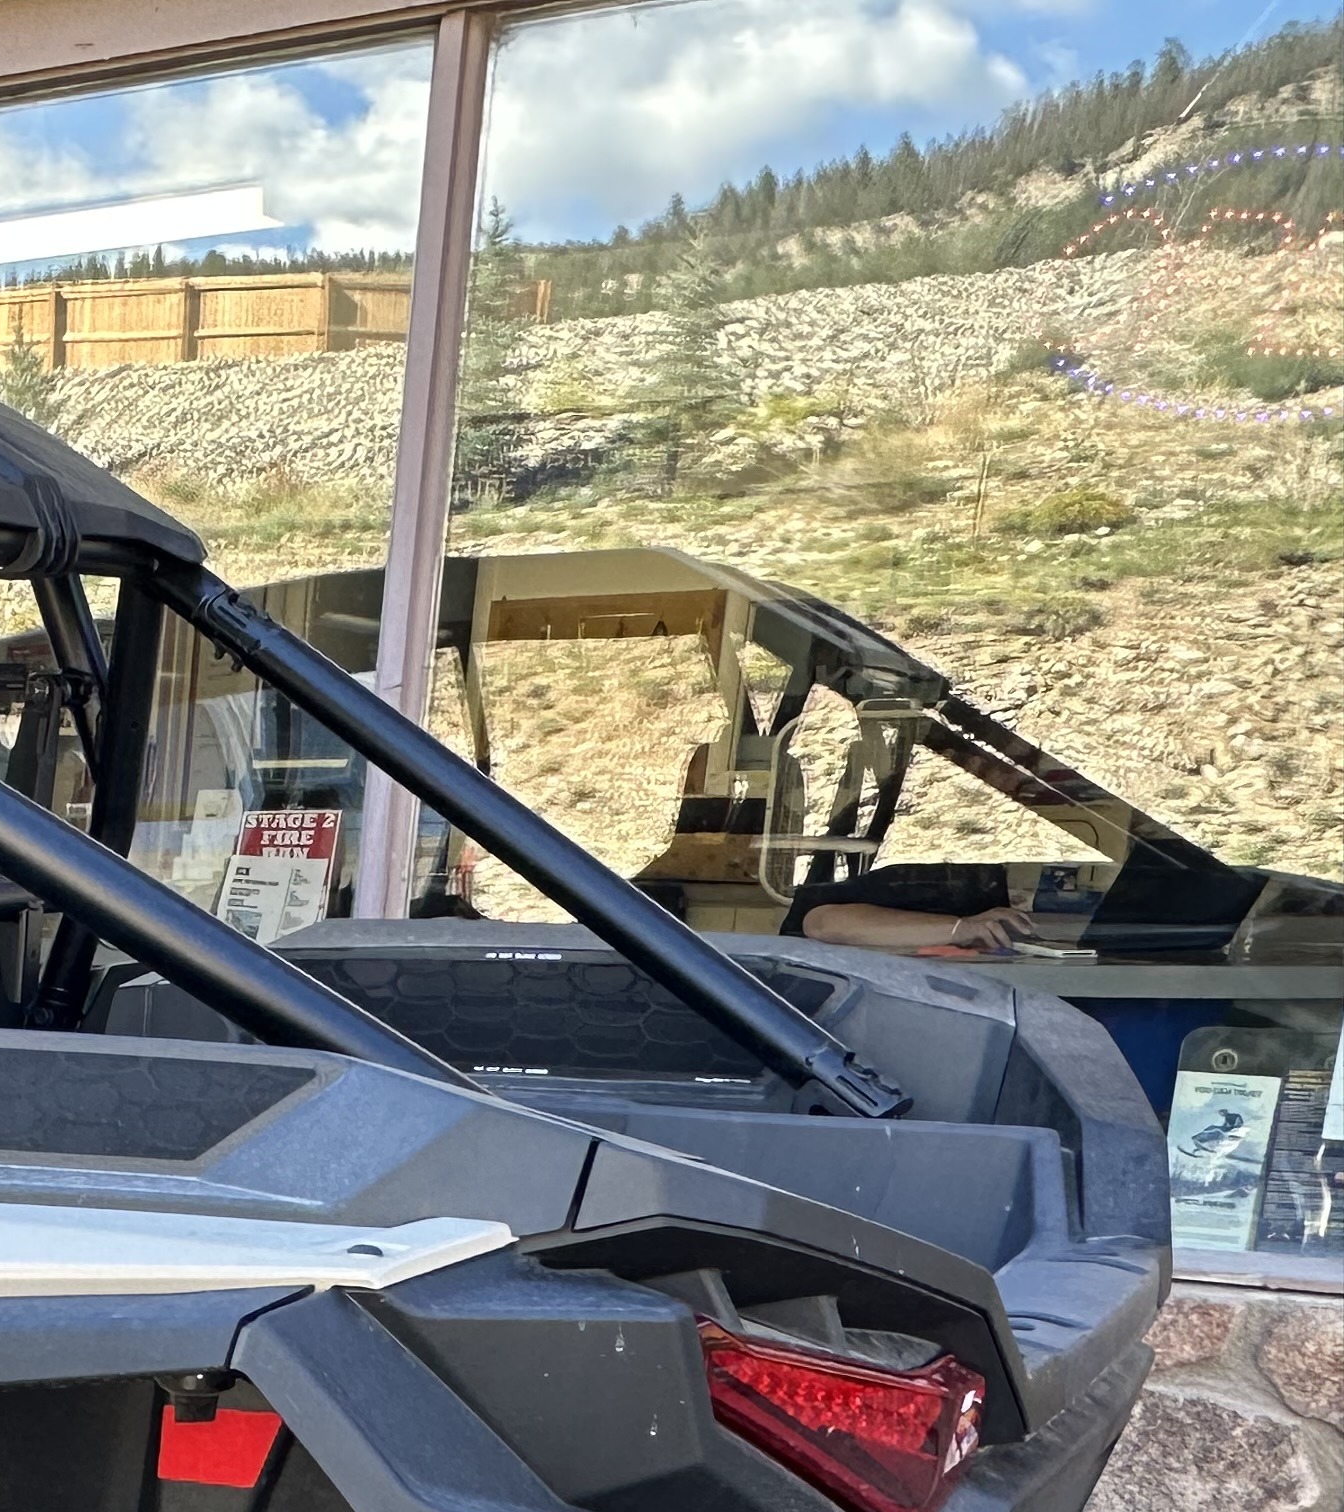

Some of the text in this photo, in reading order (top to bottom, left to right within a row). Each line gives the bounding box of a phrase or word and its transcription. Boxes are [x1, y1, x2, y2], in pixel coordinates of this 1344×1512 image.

[245, 813, 336, 829] STAGE 2
[260, 829, 316, 846] FIRE
